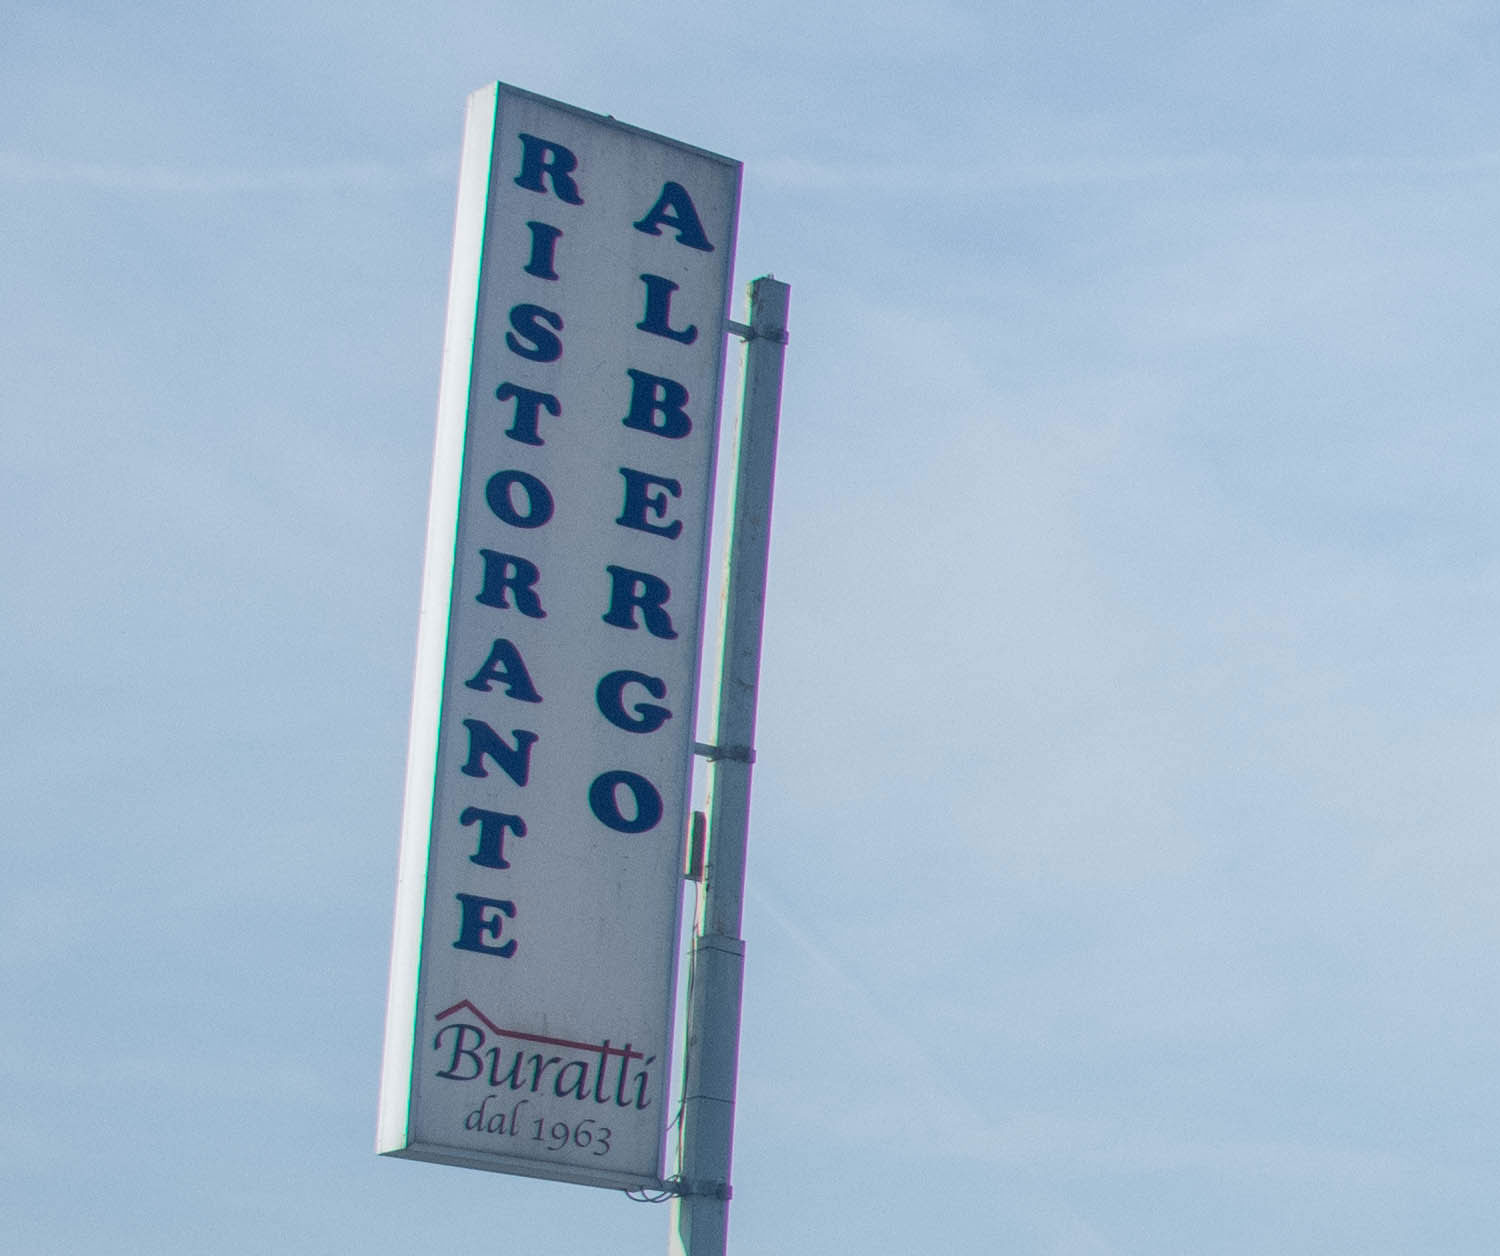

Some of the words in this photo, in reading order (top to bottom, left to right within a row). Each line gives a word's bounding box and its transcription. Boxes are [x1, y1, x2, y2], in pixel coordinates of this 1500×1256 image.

[453, 133, 584, 958] RISTORANTE
[588, 181, 715, 833] ALBERGO
[434, 1024, 656, 1110] Buratti
[465, 1094, 528, 1136] dal
[532, 1118, 612, 1156] 1963
